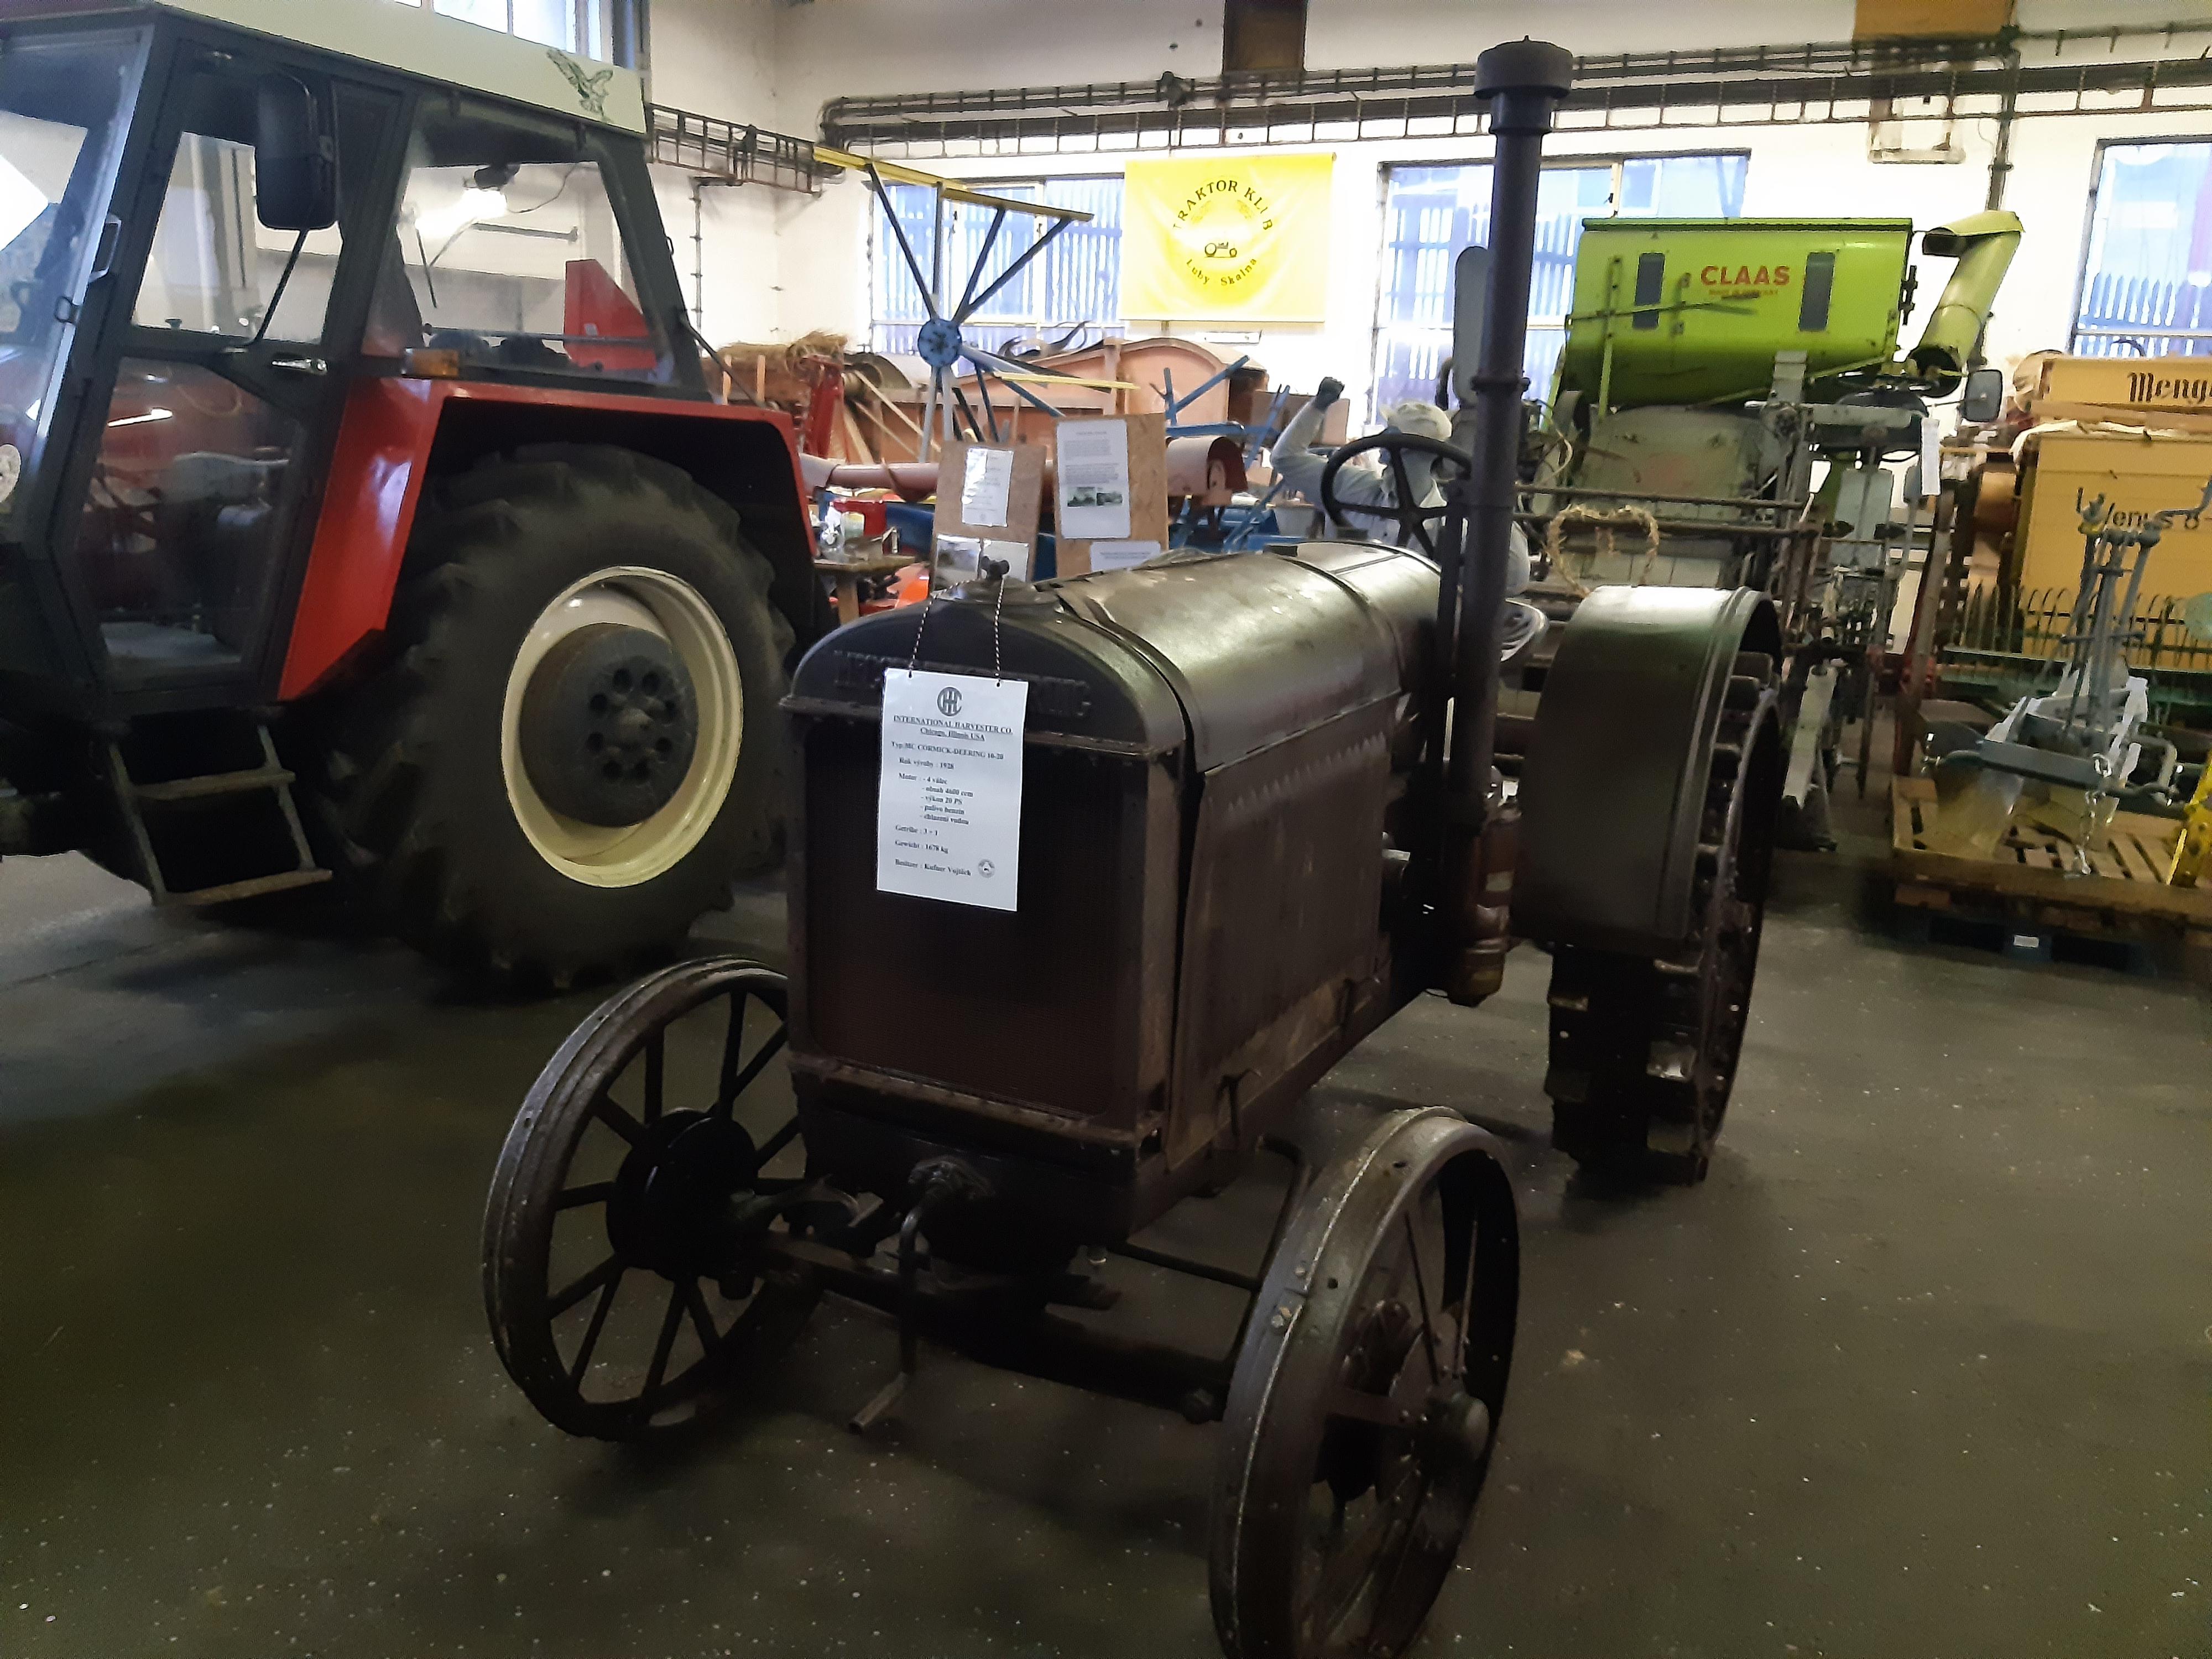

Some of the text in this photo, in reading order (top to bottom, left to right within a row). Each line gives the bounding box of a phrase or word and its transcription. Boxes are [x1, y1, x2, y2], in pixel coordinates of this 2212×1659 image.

[1172, 180, 1238, 229] TRAKTOR
[1186, 259, 1210, 284] Luby
[1700, 265, 1790, 285] CLAAS
[2127, 372, 2212, 404] Meng
[893, 714, 952, 728] INTERNATIONAL
[955, 722, 999, 733] HARVESTER
[917, 744, 985, 758] CORMICK-DEERING
[895, 839, 920, 848] Gewicht
